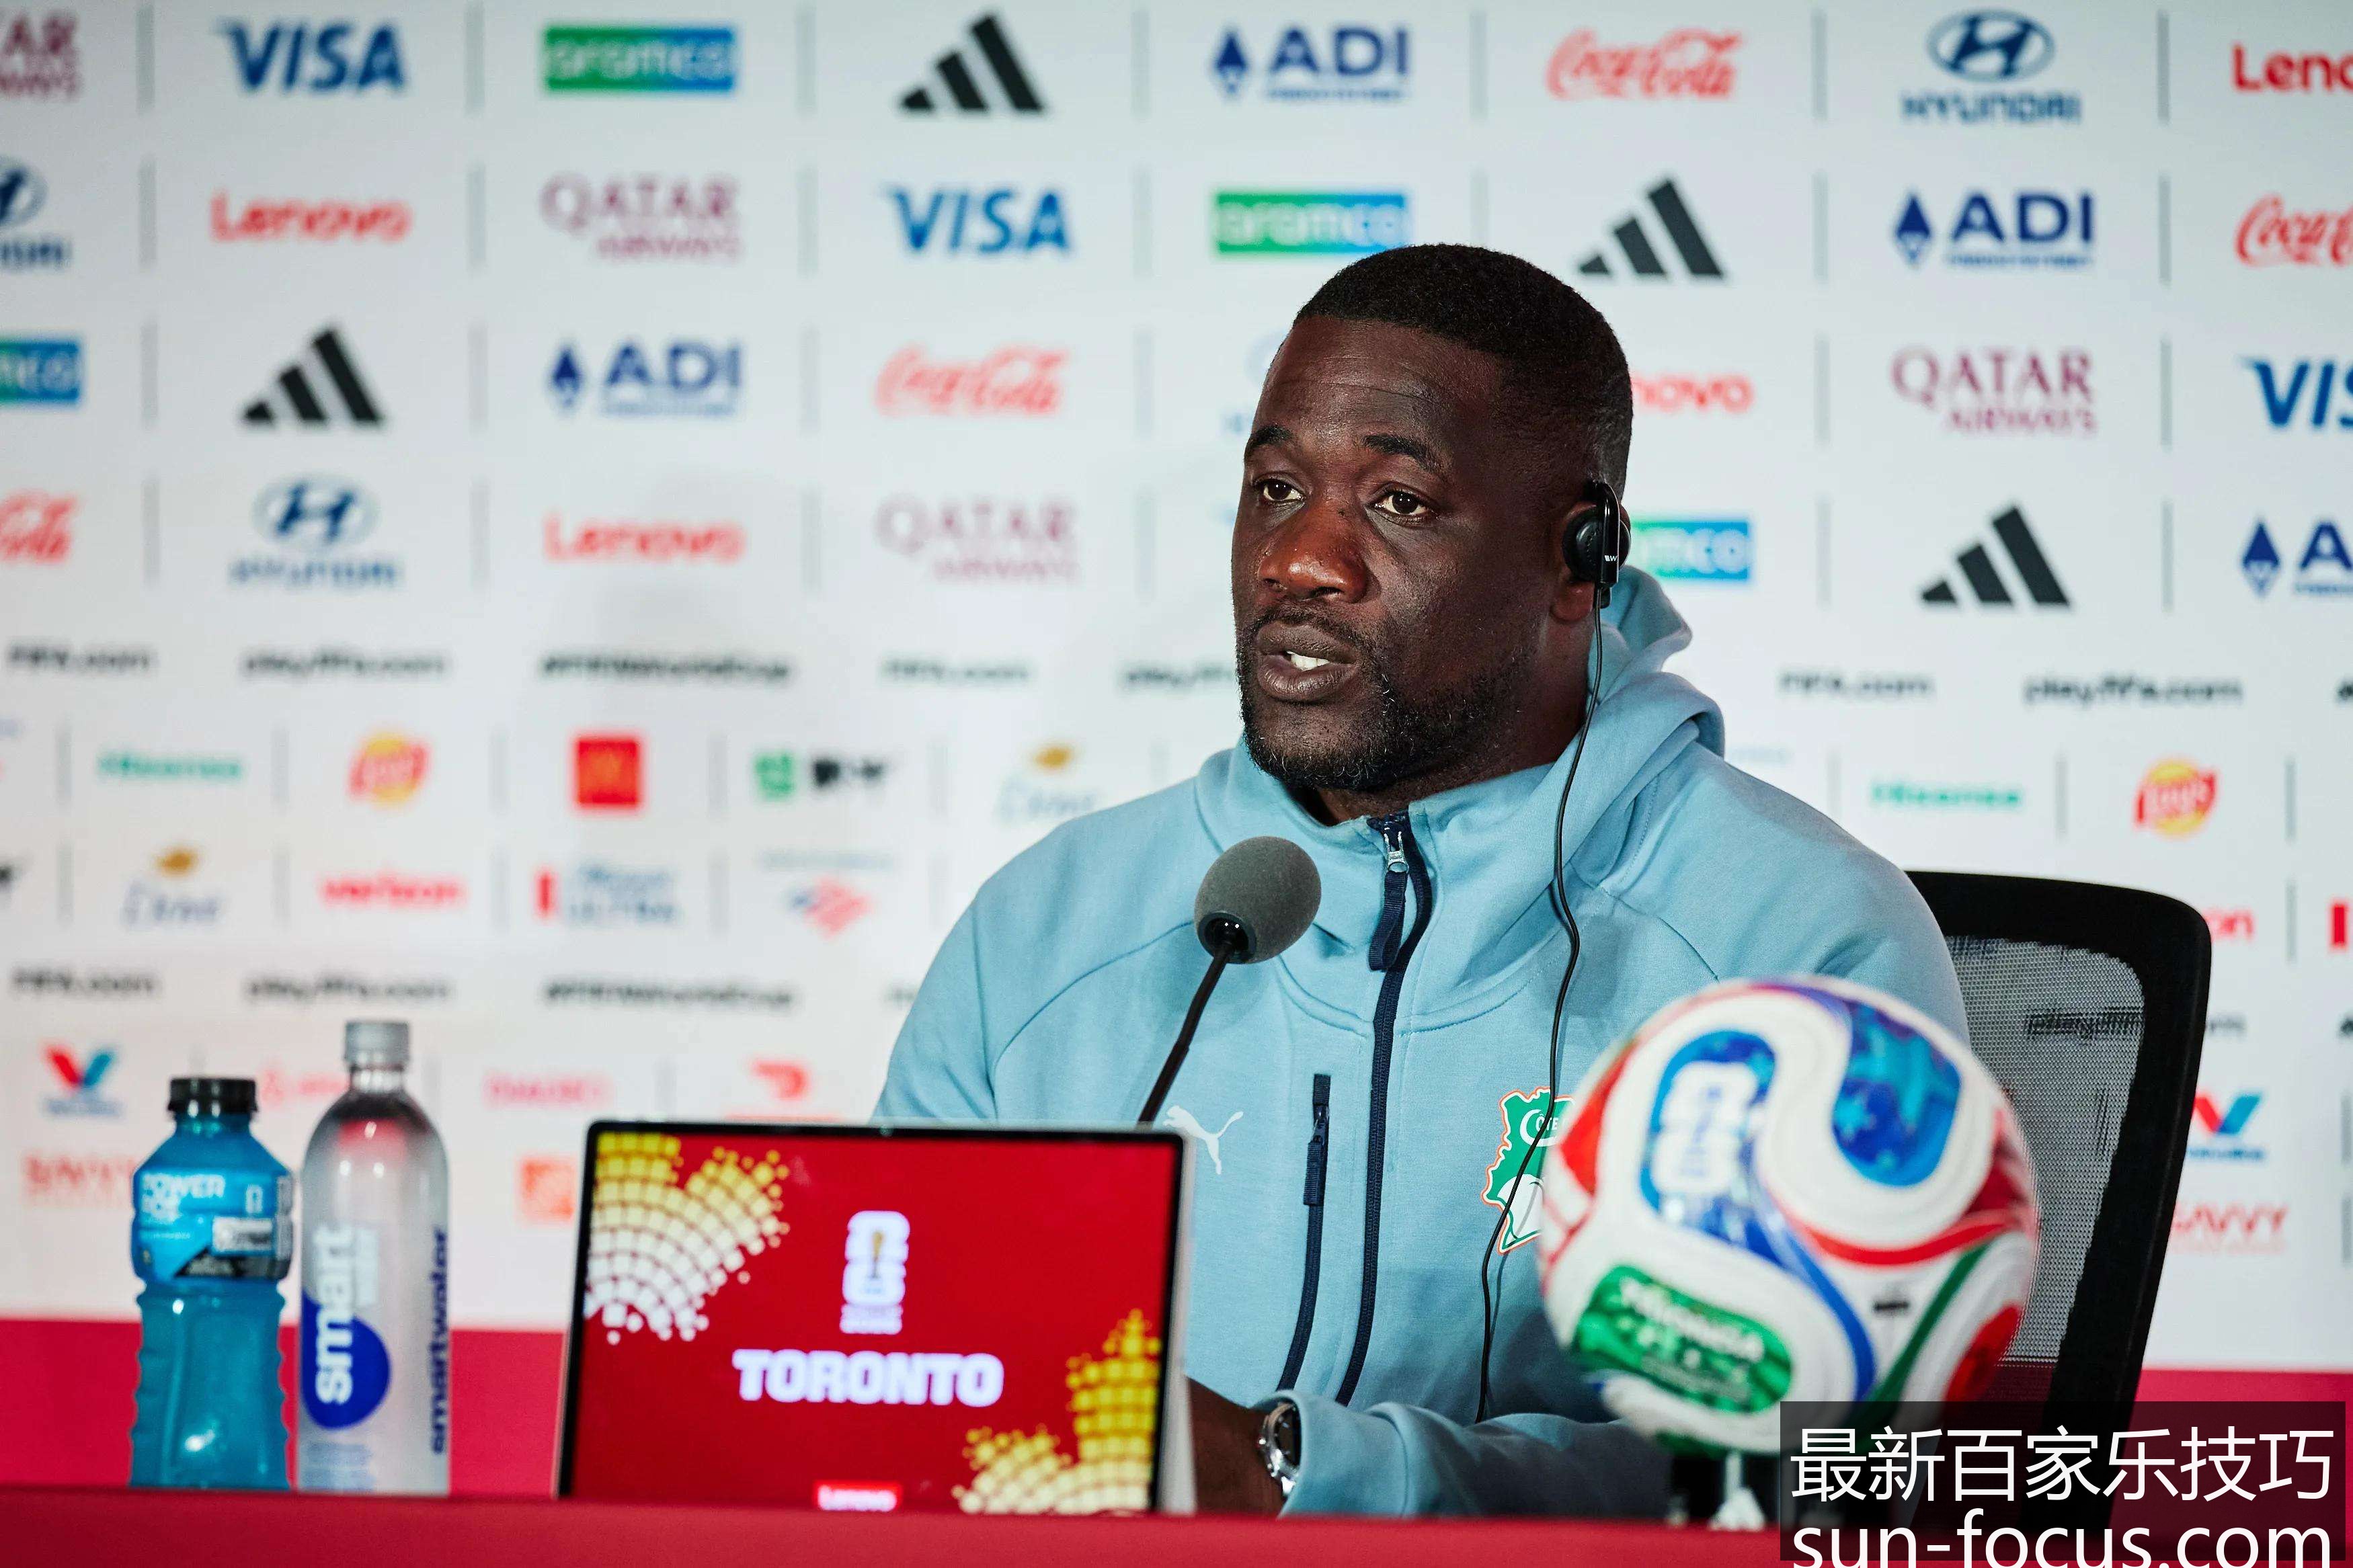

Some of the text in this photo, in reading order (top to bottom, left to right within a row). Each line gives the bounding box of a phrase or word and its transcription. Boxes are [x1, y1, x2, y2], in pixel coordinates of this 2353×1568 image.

[222, 20, 406, 93] VISA
[545, 37, 735, 81] aramco
[1268, 26, 1409, 76] ADI
[210, 192, 411, 242] Lenovo
[540, 173, 738, 234] QATAR
[889, 188, 1071, 255] VISA
[1952, 192, 2095, 244] ADI
[603, 340, 743, 390] ADI
[1890, 349, 2094, 407] QATAR
[545, 514, 746, 563] Lenovo
[314, 1225, 354, 1405] smart
[430, 1227, 448, 1455] smartwater
[732, 1348, 1004, 1407] TORONTO
